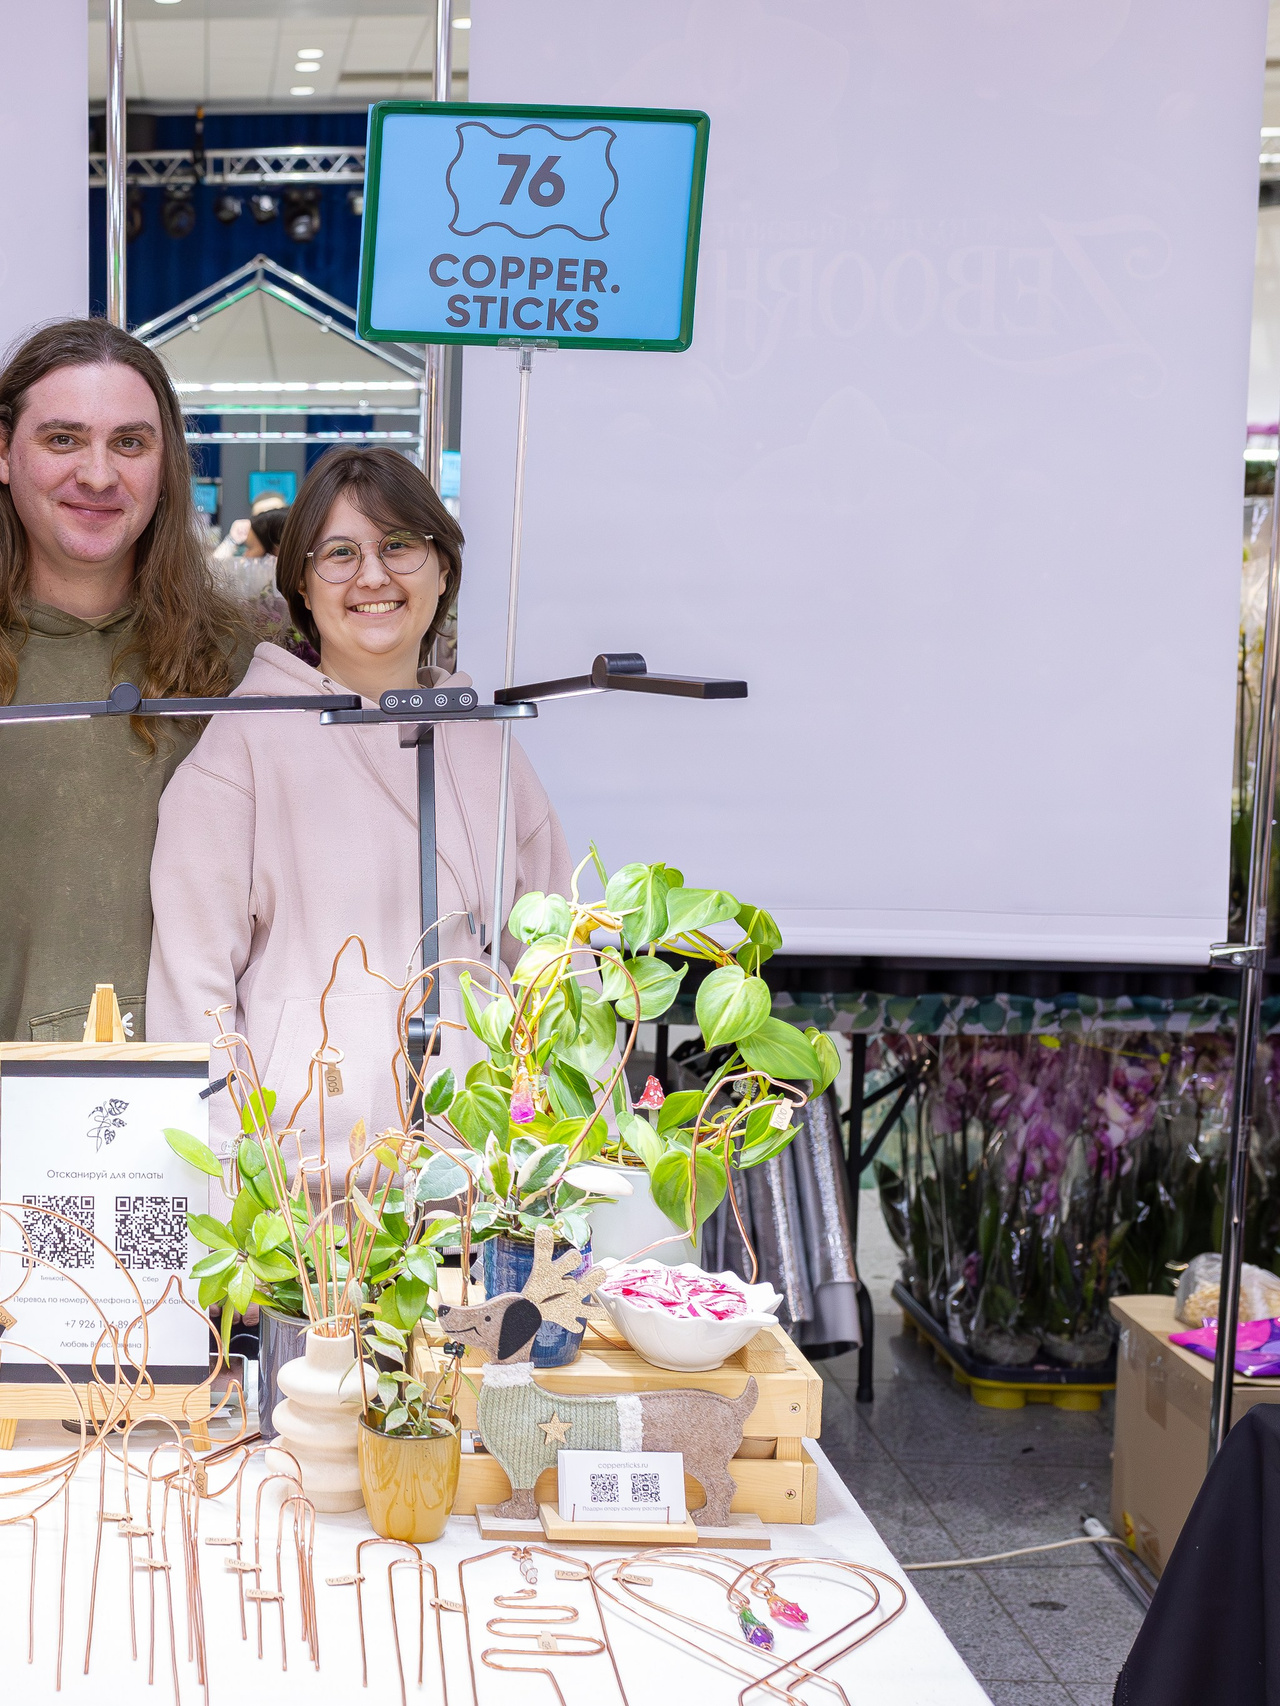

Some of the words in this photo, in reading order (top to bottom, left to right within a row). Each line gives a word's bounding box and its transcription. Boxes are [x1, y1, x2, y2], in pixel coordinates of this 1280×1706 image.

[497, 153, 566, 208] 76
[429, 253, 621, 294] COPPER.
[444, 293, 600, 333] STICKS
[327, 1075, 340, 1093] 500
[46, 1169, 108, 1180] Отсканируй
[110, 1171, 126, 1180] для
[128, 1172, 164, 1180] оплаты
[13, 1296, 47, 1304] Перевод
[60, 1297, 89, 1305] номеру
[64, 1320, 76, 1329] +7
[78, 1320, 96, 1329] 926
[59, 1340, 89, 1348] Любовь
